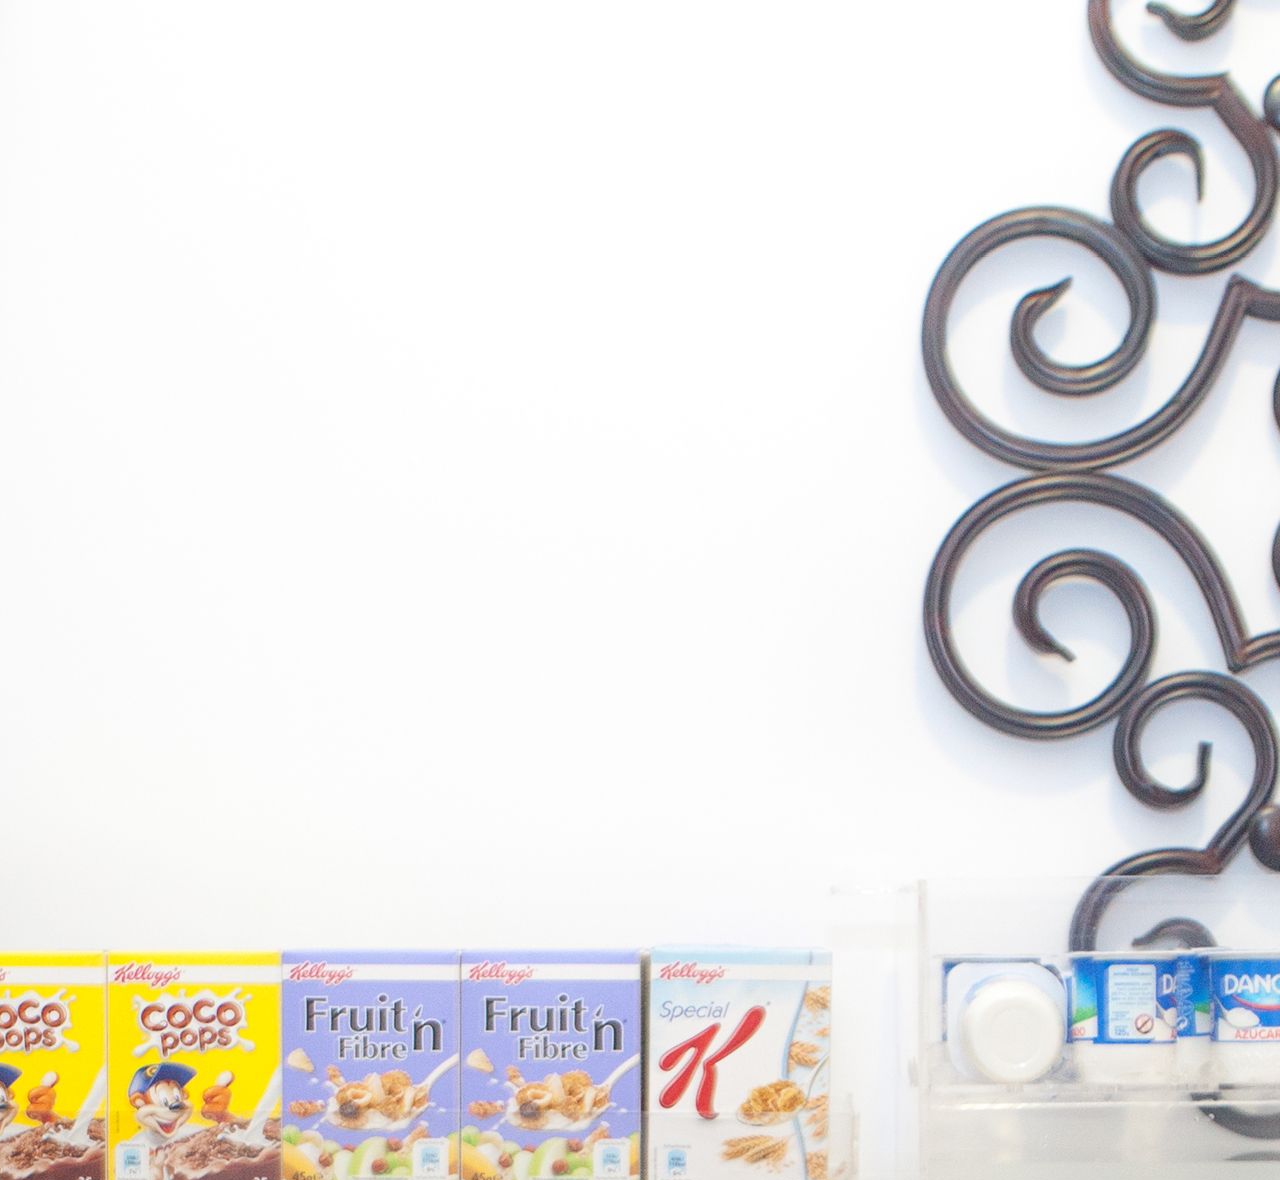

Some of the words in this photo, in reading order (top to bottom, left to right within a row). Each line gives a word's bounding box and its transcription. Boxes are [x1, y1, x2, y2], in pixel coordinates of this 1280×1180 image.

[114, 963, 181, 987] Kellogg's
[290, 962, 354, 985] Kellogg's
[468, 961, 534, 984] Kellogg's
[660, 961, 725, 984] Kellogg's
[305, 994, 408, 1032] Fruit
[484, 994, 588, 1033] Fruit
[659, 999, 730, 1023] Special
[338, 1035, 408, 1059] Fibre
[518, 1035, 588, 1060] Fibre
[658, 1003, 767, 1120] K
